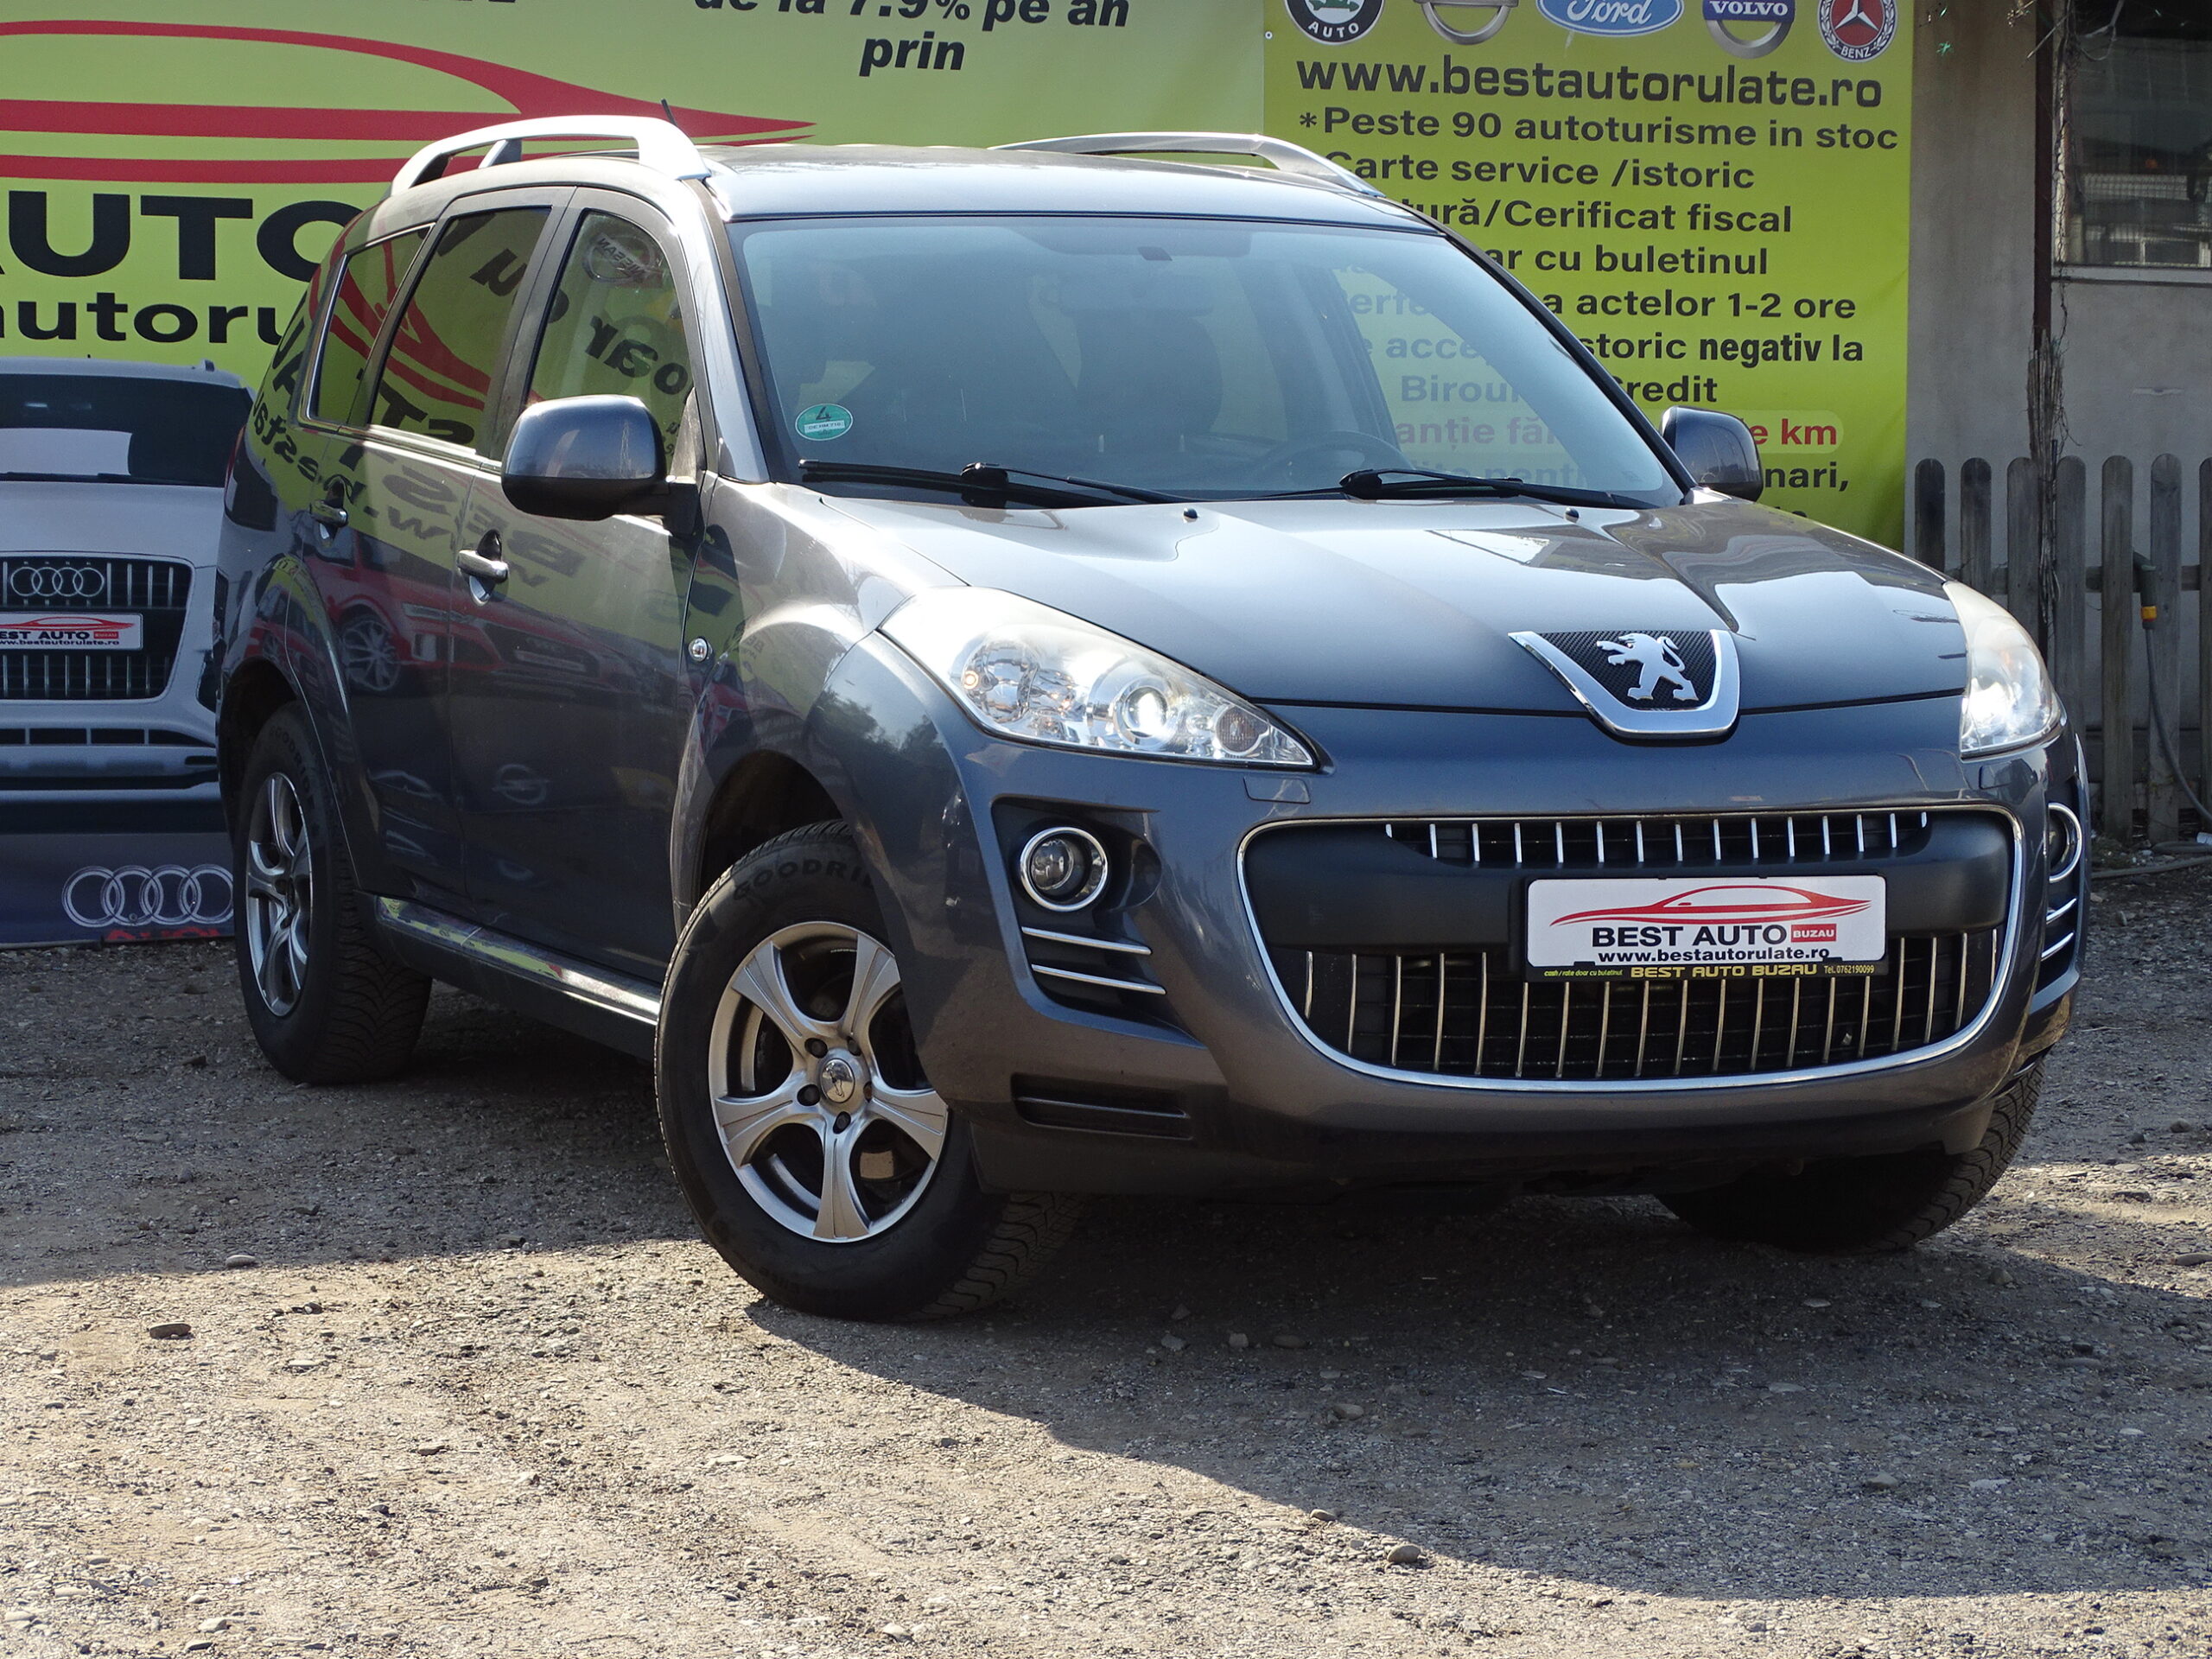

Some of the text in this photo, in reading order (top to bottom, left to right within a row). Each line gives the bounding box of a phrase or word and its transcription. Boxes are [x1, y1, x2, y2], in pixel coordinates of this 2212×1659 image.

[982, 0, 1050, 31] pe
[1067, 0, 1129, 27] an
[1708, 0, 1789, 16] VOLVO
[1308, 22, 1359, 39] AUTO
[858, 31, 965, 77] prin
[1840, 45, 1872, 59] BENZ
[1296, 54, 1882, 107] www.bestautorulate.ro
[1452, 111, 1502, 138] 90
[1515, 116, 1757, 145] autoturisme
[1769, 119, 1802, 147] in
[1815, 124, 1898, 149] stoc
[1451, 156, 1599, 185] service
[1611, 158, 1756, 188] /istoric
[1688, 203, 1791, 232] fiscal
[0, 190, 364, 283] UTO
[1484, 245, 1768, 275] ar cu buletinul
[0, 292, 282, 346] utor
[1576, 289, 1716, 316] actelor
[1727, 293, 1782, 318] 1-2
[1793, 298, 1855, 319] ore
[1580, 332, 1864, 368] storic negativ la
[1401, 374, 1521, 403] Birou
[1612, 375, 1718, 403] redit
[1781, 418, 1837, 445] km
[1764, 461, 1849, 491] nari,
[1592, 925, 1835, 947] BEST AUTO BUZAU
[1599, 947, 1830, 963] www.bestautorulate.ro
[1630, 966, 1686, 978] BEST
[1691, 965, 1745, 978] AUTO
[1751, 963, 1817, 976] BUZAU
